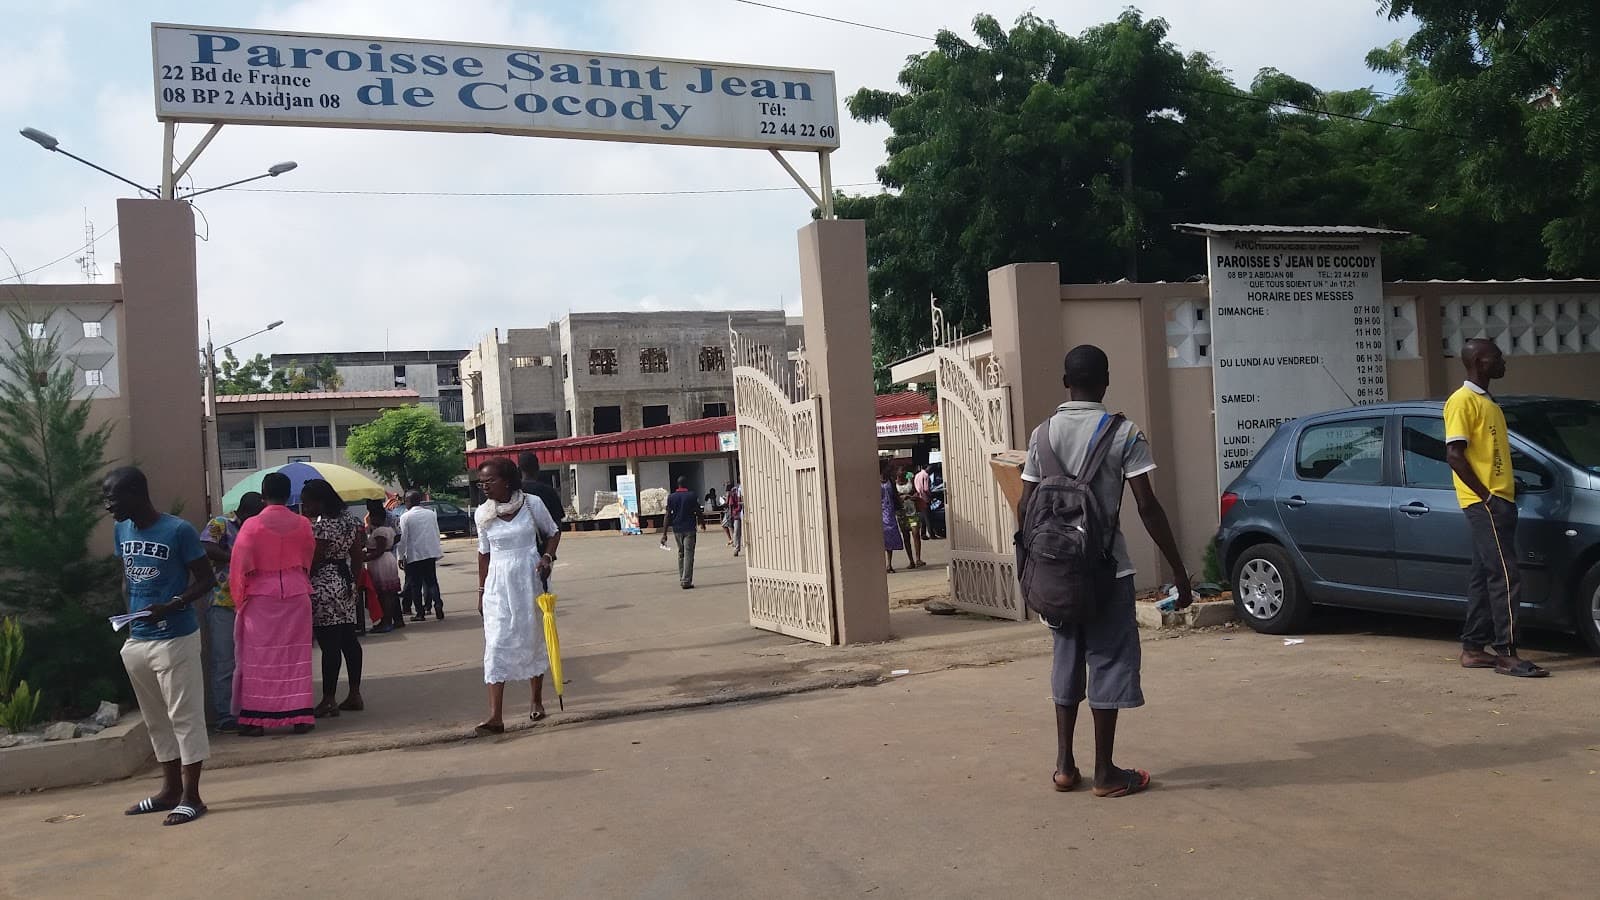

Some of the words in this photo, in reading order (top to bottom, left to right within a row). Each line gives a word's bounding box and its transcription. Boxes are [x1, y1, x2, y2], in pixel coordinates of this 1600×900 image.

[189, 33, 484, 78] Paroisse
[506, 52, 668, 91] Saint
[686, 67, 813, 101] Jean
[162, 65, 184, 81] 22
[191, 66, 217, 83] Bd
[222, 69, 243, 84] de
[249, 70, 311, 88] France
[163, 87, 186, 104] 08
[191, 88, 220, 104] BP
[224, 90, 235, 105] 2
[240, 90, 314, 111] Abidjan
[319, 93, 341, 109] 08
[357, 77, 435, 107] de
[458, 80, 693, 130] Cocody
[759, 102, 787, 117] Tél:
[760, 121, 777, 135] 22
[780, 122, 797, 136] 44
[800, 123, 816, 137] 22
[819, 124, 835, 139] 60
[1217, 256, 1271, 268] PAROISSE
[1285, 256, 1314, 268] JEAN
[1317, 256, 1331, 268] DE
[1333, 256, 1376, 268] COCODY
[1247, 291, 1291, 302] HORAIRE
[1293, 291, 1313, 302] DES
[1315, 291, 1354, 301] MESSES
[1218, 307, 1265, 316] DIMANCHE
[1354, 305, 1362, 314] 07
[1364, 305, 1370, 314] H
[1371, 305, 1380, 314] 00
[1354, 316, 1363, 325] 09
[1365, 316, 1370, 325] H
[1371, 316, 1380, 325] 00
[1356, 327, 1363, 336] 11
[1365, 327, 1371, 336] H
[1372, 327, 1381, 336] 00
[1366, 341, 1371, 349] H
[1220, 359, 1233, 368] DU
[1235, 358, 1261, 367] LUNDI
[1262, 357, 1275, 366] AU
[1277, 355, 1319, 365] VENDREDI
[1366, 354, 1372, 362] H
[1367, 365, 1373, 374] H
[1358, 376, 1367, 385] 19
[1368, 376, 1373, 385] H
[1375, 376, 1384, 385] 00
[1367, 388, 1373, 397] H
[1221, 394, 1255, 404] SAMEDI
[1237, 418, 1282, 430] HORAIRE
[1223, 435, 1250, 445] LUNDI
[1223, 448, 1249, 458] JEUDI
